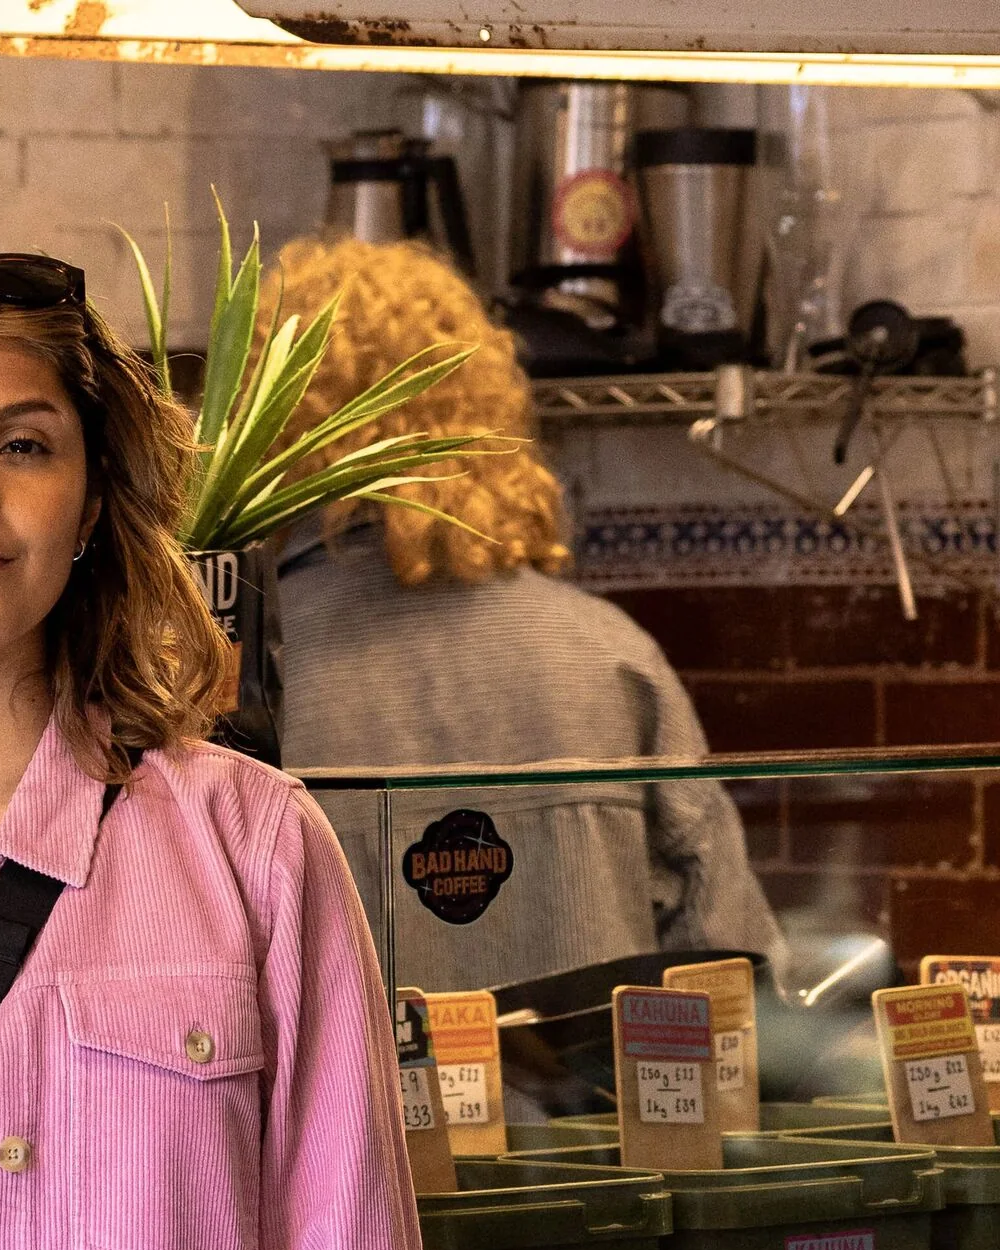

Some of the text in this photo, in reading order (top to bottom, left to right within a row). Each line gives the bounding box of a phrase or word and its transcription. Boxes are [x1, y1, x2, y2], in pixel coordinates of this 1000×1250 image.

[411, 847, 507, 880] BAD HAND
[433, 875, 488, 896] COFFEE
[629, 999, 701, 1023] KAHUNA
